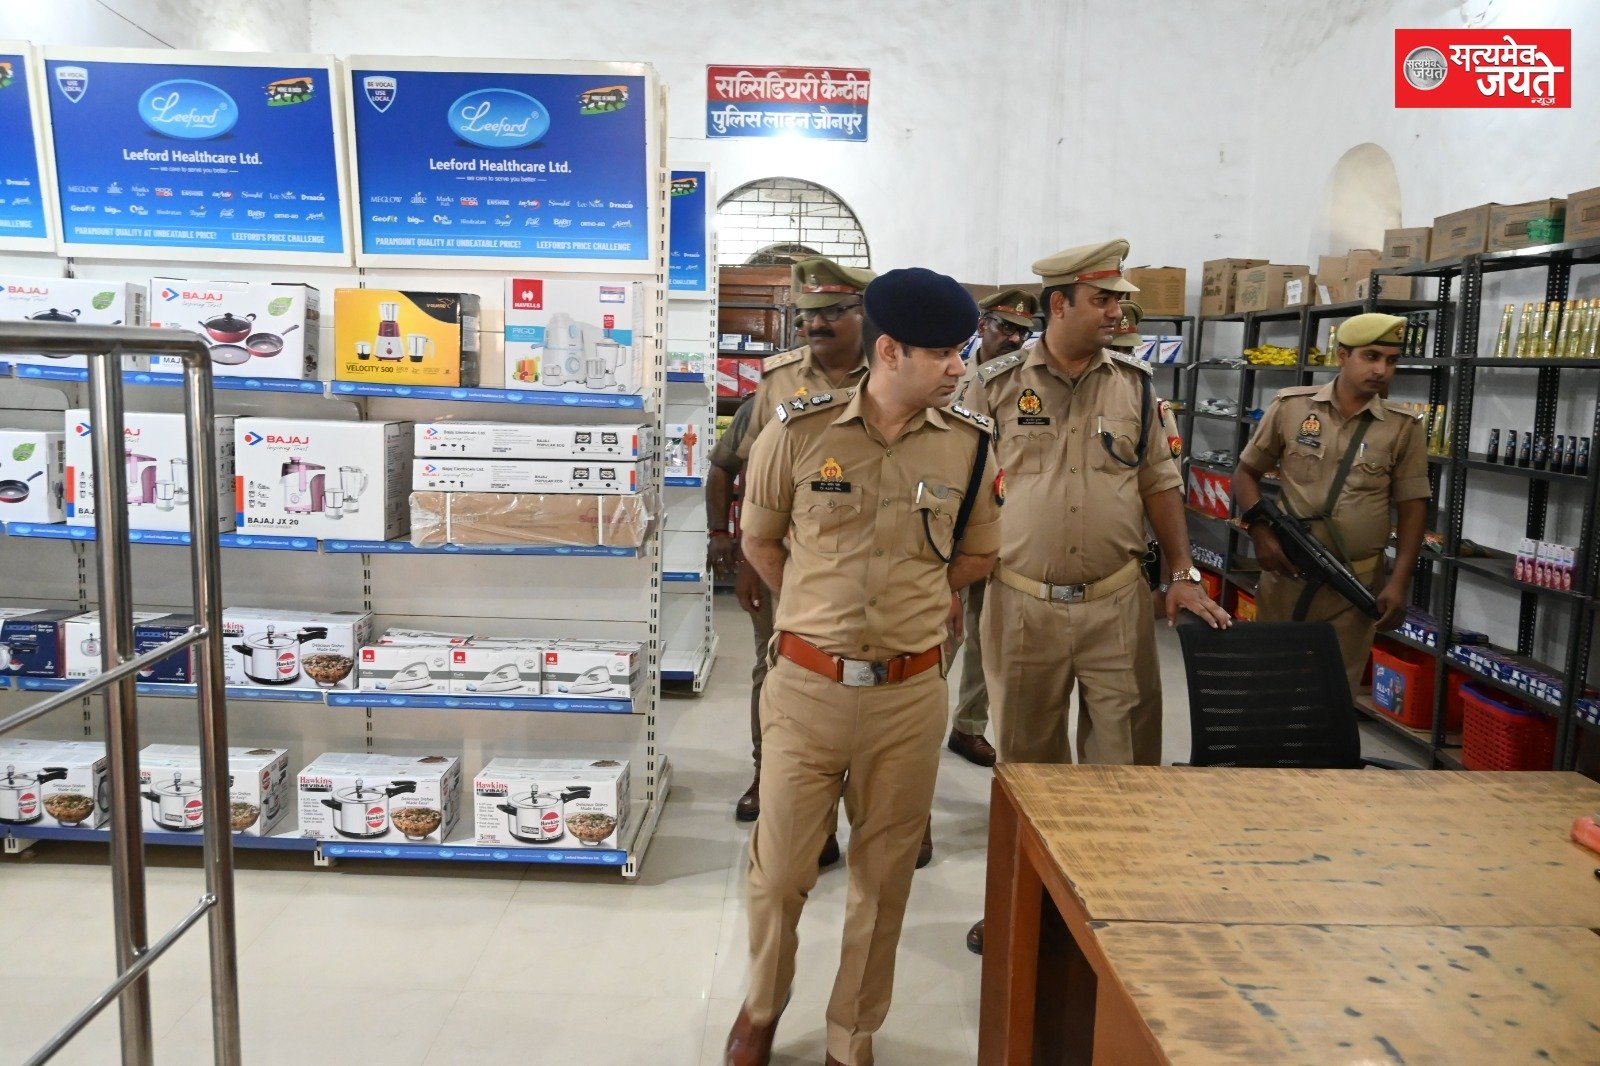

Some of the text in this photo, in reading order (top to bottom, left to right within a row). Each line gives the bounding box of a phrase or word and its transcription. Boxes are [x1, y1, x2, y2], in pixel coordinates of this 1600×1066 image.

[151, 91, 219, 128] Leeford
[461, 101, 532, 137] Leeford
[711, 104, 863, 134] पुलिस लाइन जौनपुर
[123, 148, 263, 165] Leeford Healthcare Ltd.
[429, 158, 572, 173] Leeford Healthcare Ltd.
[74, 226, 113, 236] PARAMOUNT
[115, 228, 142, 237] QUALITY
[144, 229, 152, 237] AT
[154, 230, 195, 239] UNBEATABLE
[232, 232, 267, 241] LEEFORD'S
[267, 233, 286, 242] PRICE
[287, 234, 326, 243] CHALLENGE
[375, 237, 415, 246] PARAMOUNT
[417, 238, 444, 247] QUALITY
[446, 239, 454, 247] AT
[456, 239, 498, 248] UNBEATABLE
[536, 241, 572, 250] LEEFORD'S
[573, 242, 592, 250] PRICE
[593, 243, 631, 251] CHALLENGE
[8, 285, 48, 295] BAJAJ
[182, 291, 223, 301] BAJAJ
[346, 364, 379, 373] VELOCITY
[266, 435, 309, 444] BAJAJ
[78, 507, 95, 515] BAJ
[300, 776, 333, 784] Hawkins
[476, 781, 508, 790] Hawkins
[365, 813, 385, 821] Hawkins
